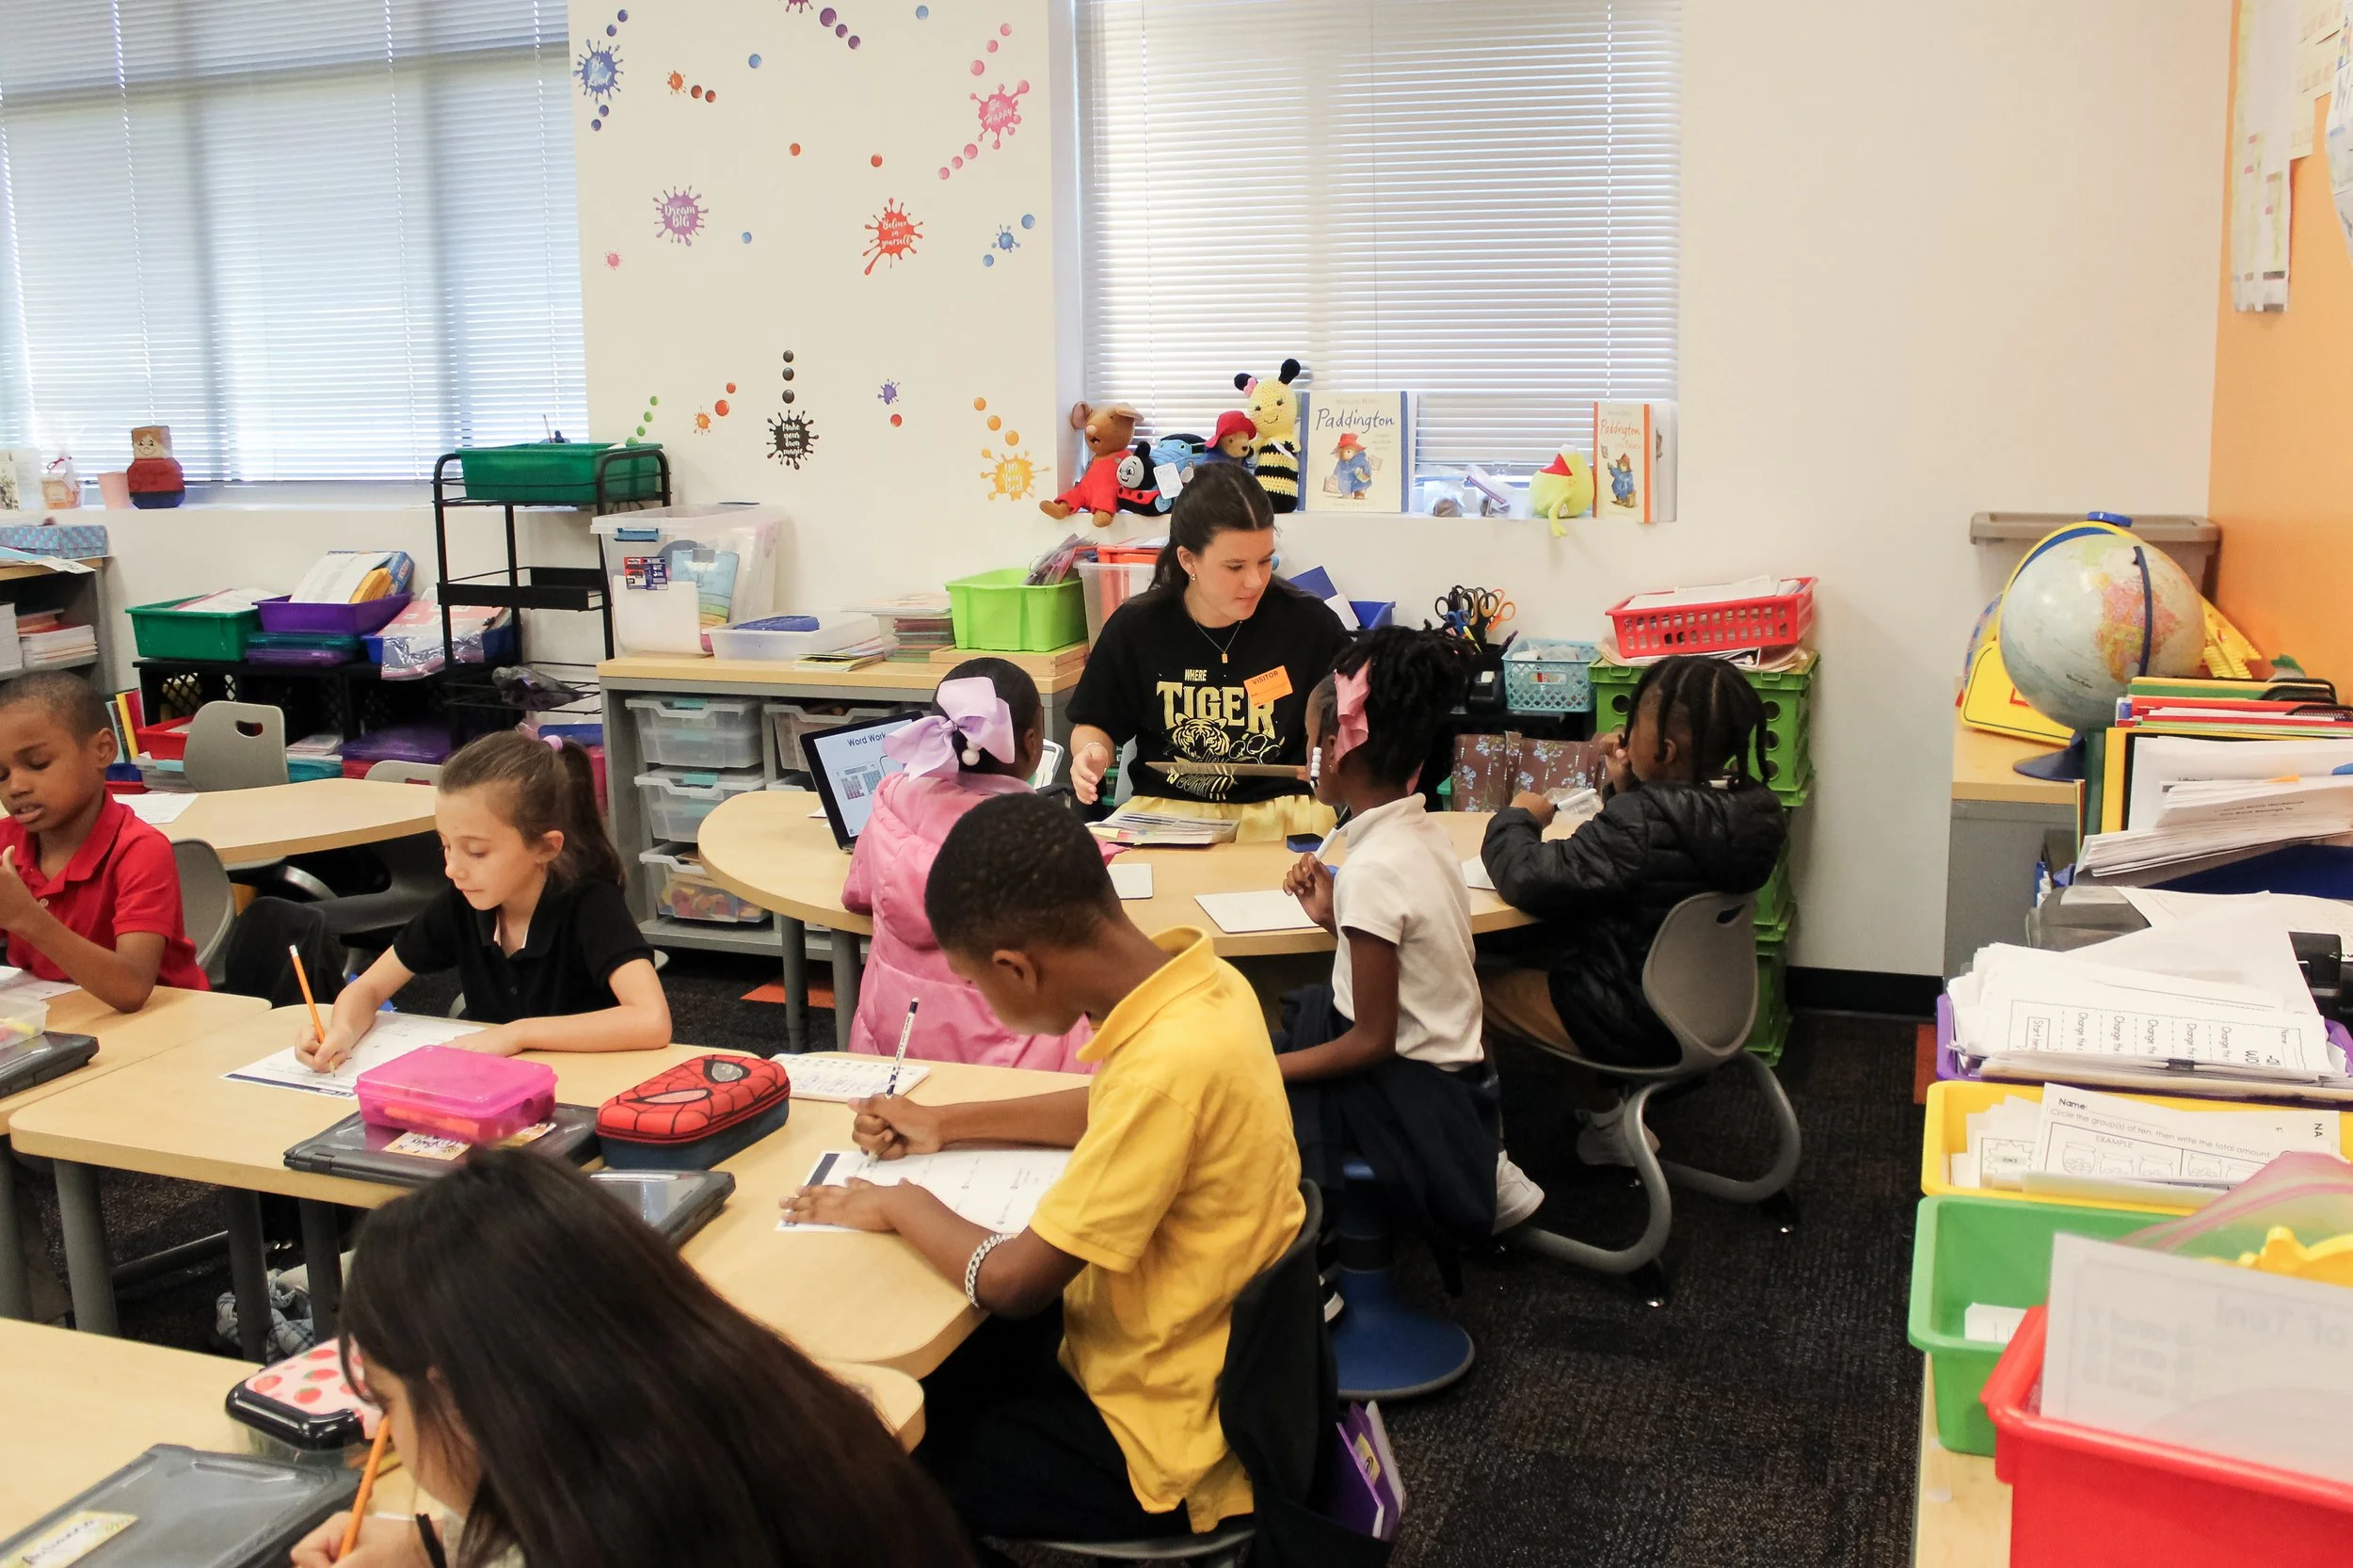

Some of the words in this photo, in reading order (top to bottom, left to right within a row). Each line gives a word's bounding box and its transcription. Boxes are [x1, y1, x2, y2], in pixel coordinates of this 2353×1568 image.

[984, 106, 1012, 124] Happy
[664, 204, 696, 217] Dream
[672, 215, 690, 227] BIG
[882, 218, 907, 230] Believe
[1316, 408, 1396, 434] Paddington
[1600, 419, 1641, 439] Paddington
[1184, 668, 1208, 682] WHERE
[1251, 670, 1279, 685] VISITOR
[847, 736, 868, 747] Word
[2032, 1019, 2044, 1037] Start
[2074, 1012, 2089, 1037] Change
[2110, 1016, 2125, 1041] Change
[2144, 1018, 2159, 1043] Change
[2184, 1022, 2198, 1046] Change
[2218, 1026, 2232, 1048] Change
[2051, 1109, 2074, 1119] Circle
[2075, 1112, 2090, 1123] the
[2091, 1116, 2125, 1131] group(s)
[2127, 1124, 2137, 1132] of
[2155, 1130, 2175, 1140] then
[2177, 1135, 2197, 1144] write
[2199, 1139, 2213, 1148] the
[2215, 1143, 2235, 1152] total
[2095, 1135, 2134, 1149] EXAMPLE
